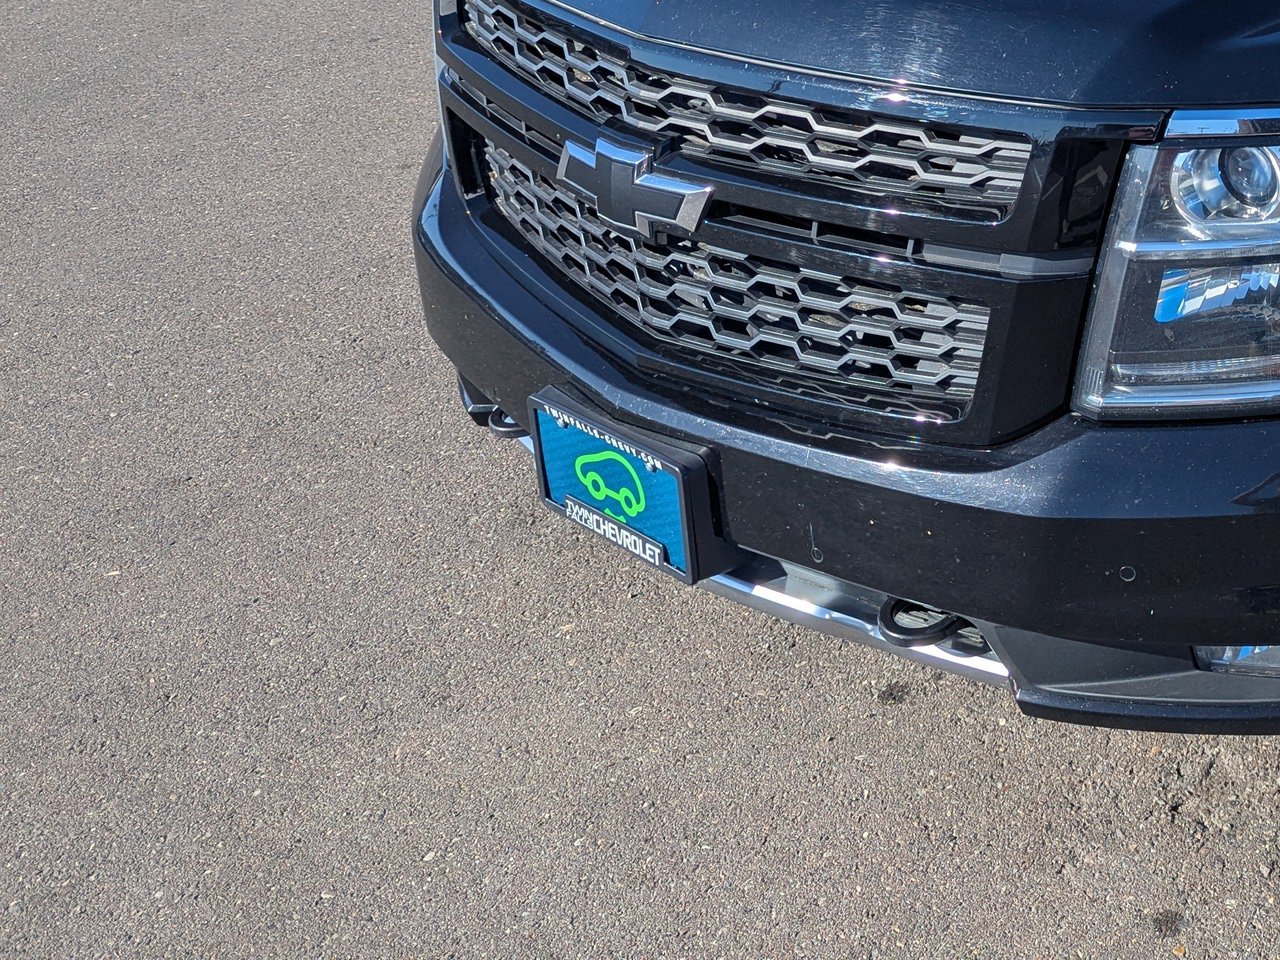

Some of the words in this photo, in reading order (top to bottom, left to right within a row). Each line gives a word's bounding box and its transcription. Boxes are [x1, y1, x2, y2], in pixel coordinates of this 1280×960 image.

[565, 499, 594, 523] TWIN
[566, 511, 594, 531] FALLS
[593, 515, 661, 567] CHEVROLET
